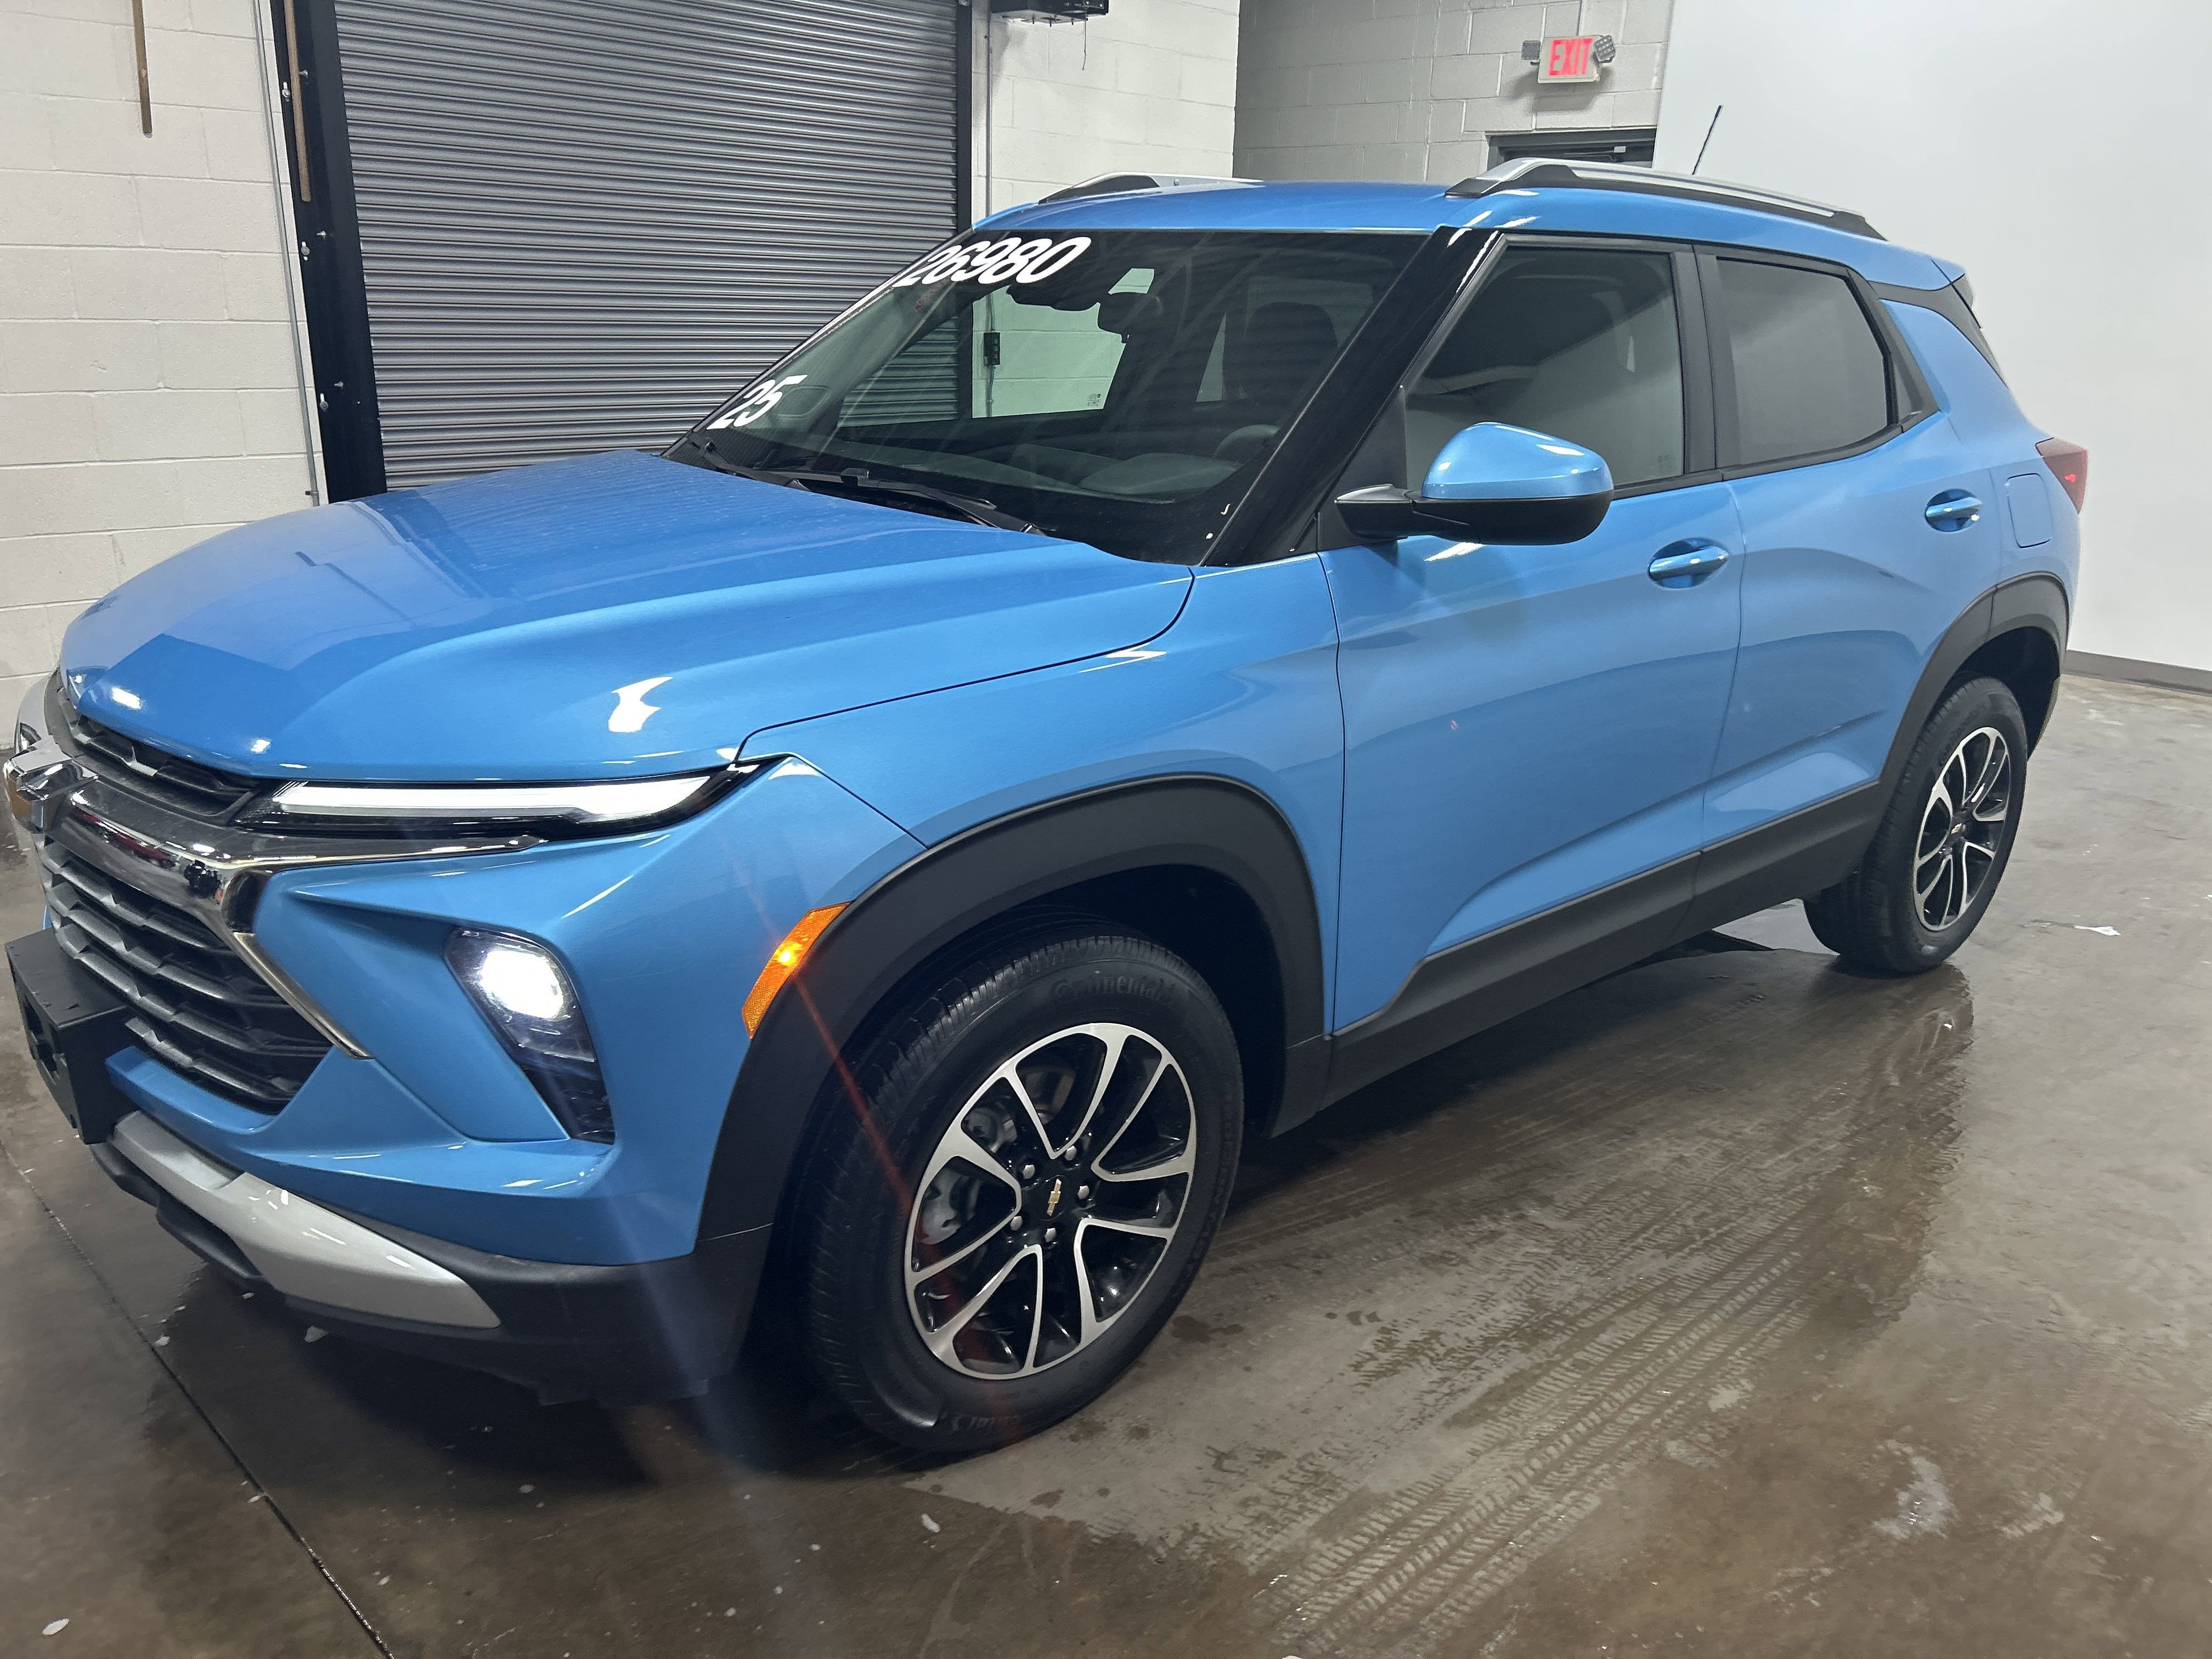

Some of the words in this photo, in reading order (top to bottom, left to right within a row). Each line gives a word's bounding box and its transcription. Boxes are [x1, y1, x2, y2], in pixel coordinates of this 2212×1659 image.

[1548, 37, 1593, 77] EXIT
[892, 236, 1092, 287] 26980
[707, 374, 808, 430] 25
